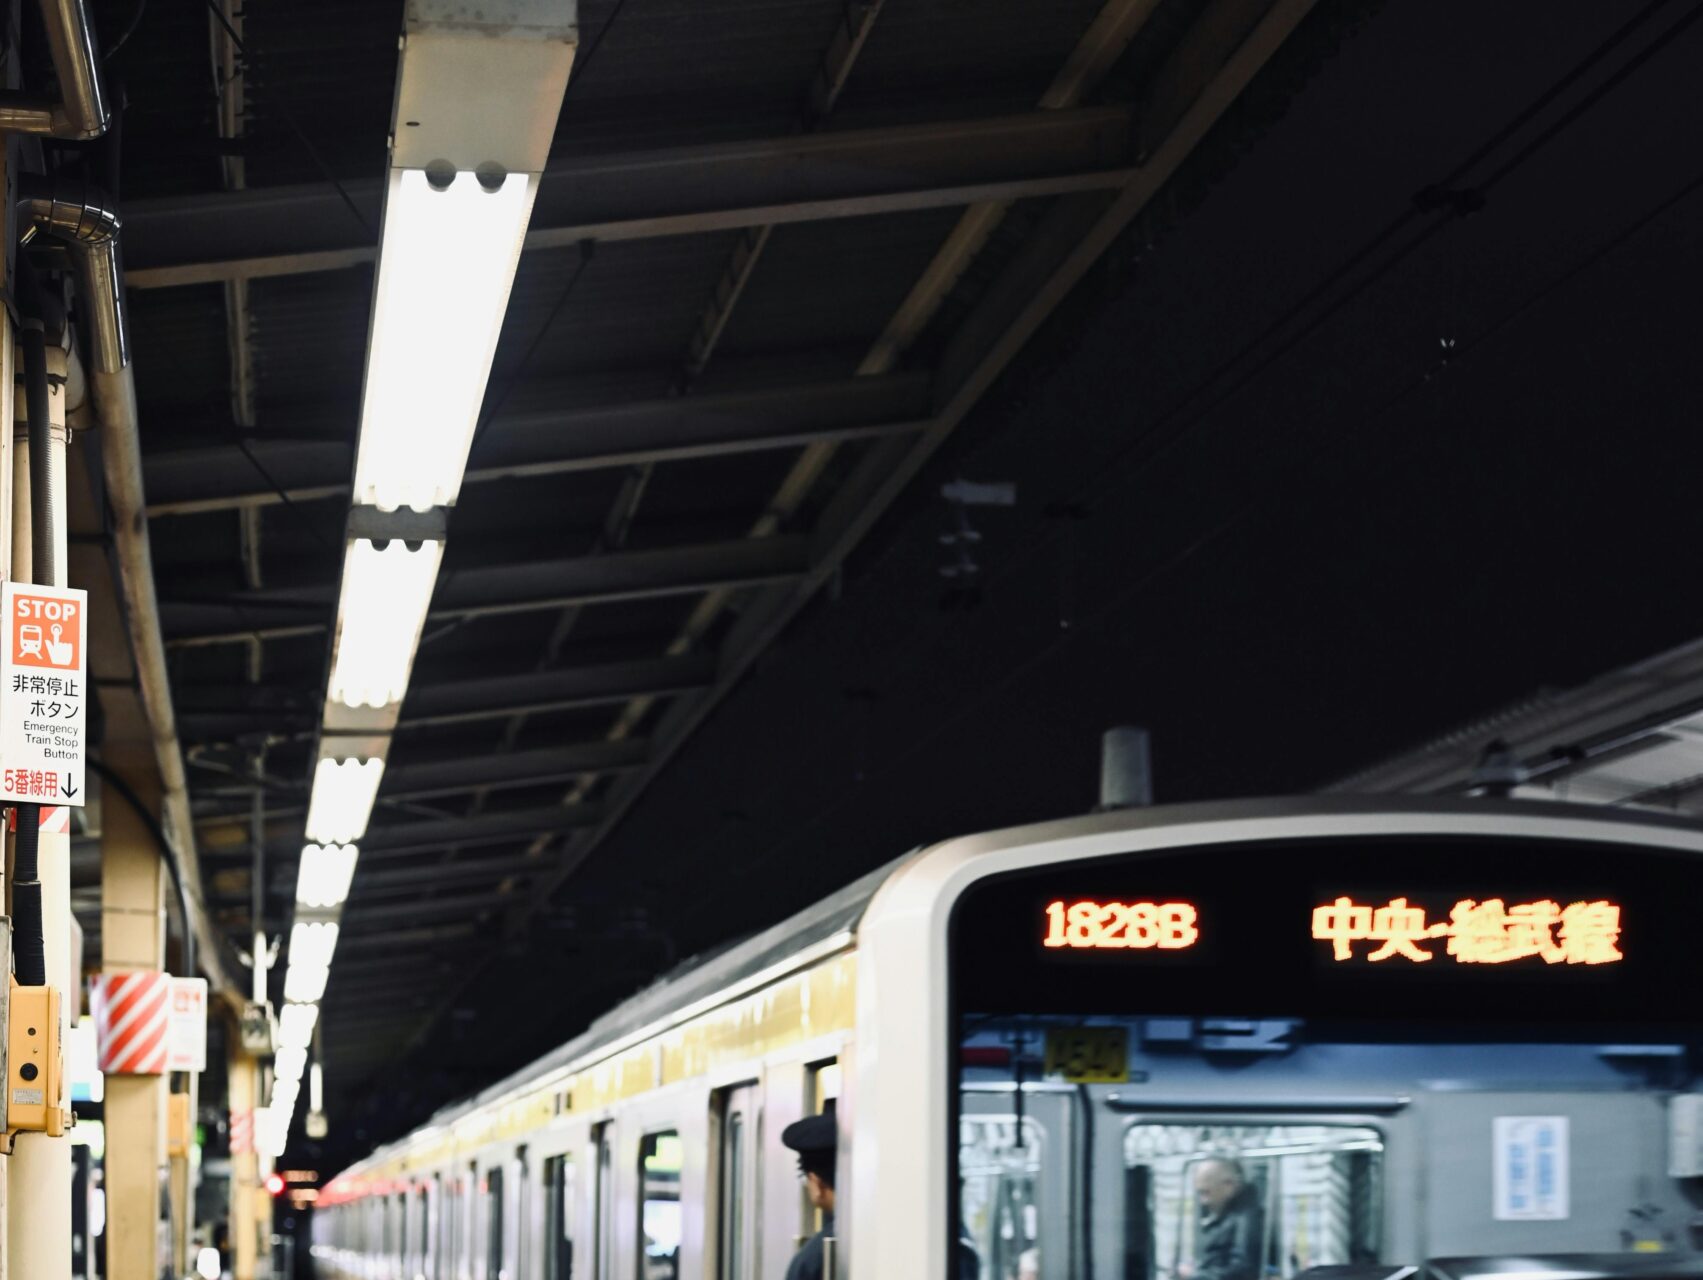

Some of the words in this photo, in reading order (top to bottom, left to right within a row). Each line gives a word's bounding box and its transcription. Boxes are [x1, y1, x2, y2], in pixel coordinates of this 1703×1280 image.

[17, 598, 76, 621] STOP
[12, 673, 79, 697] 非常停止
[30, 699, 79, 719] ボタン
[23, 720, 79, 736] Emergency
[25, 733, 51, 745] Train
[54, 735, 79, 749] Stop
[44, 747, 79, 760] Button
[4, 768, 58, 798] 5番線用
[1043, 900, 1199, 950] 1828B
